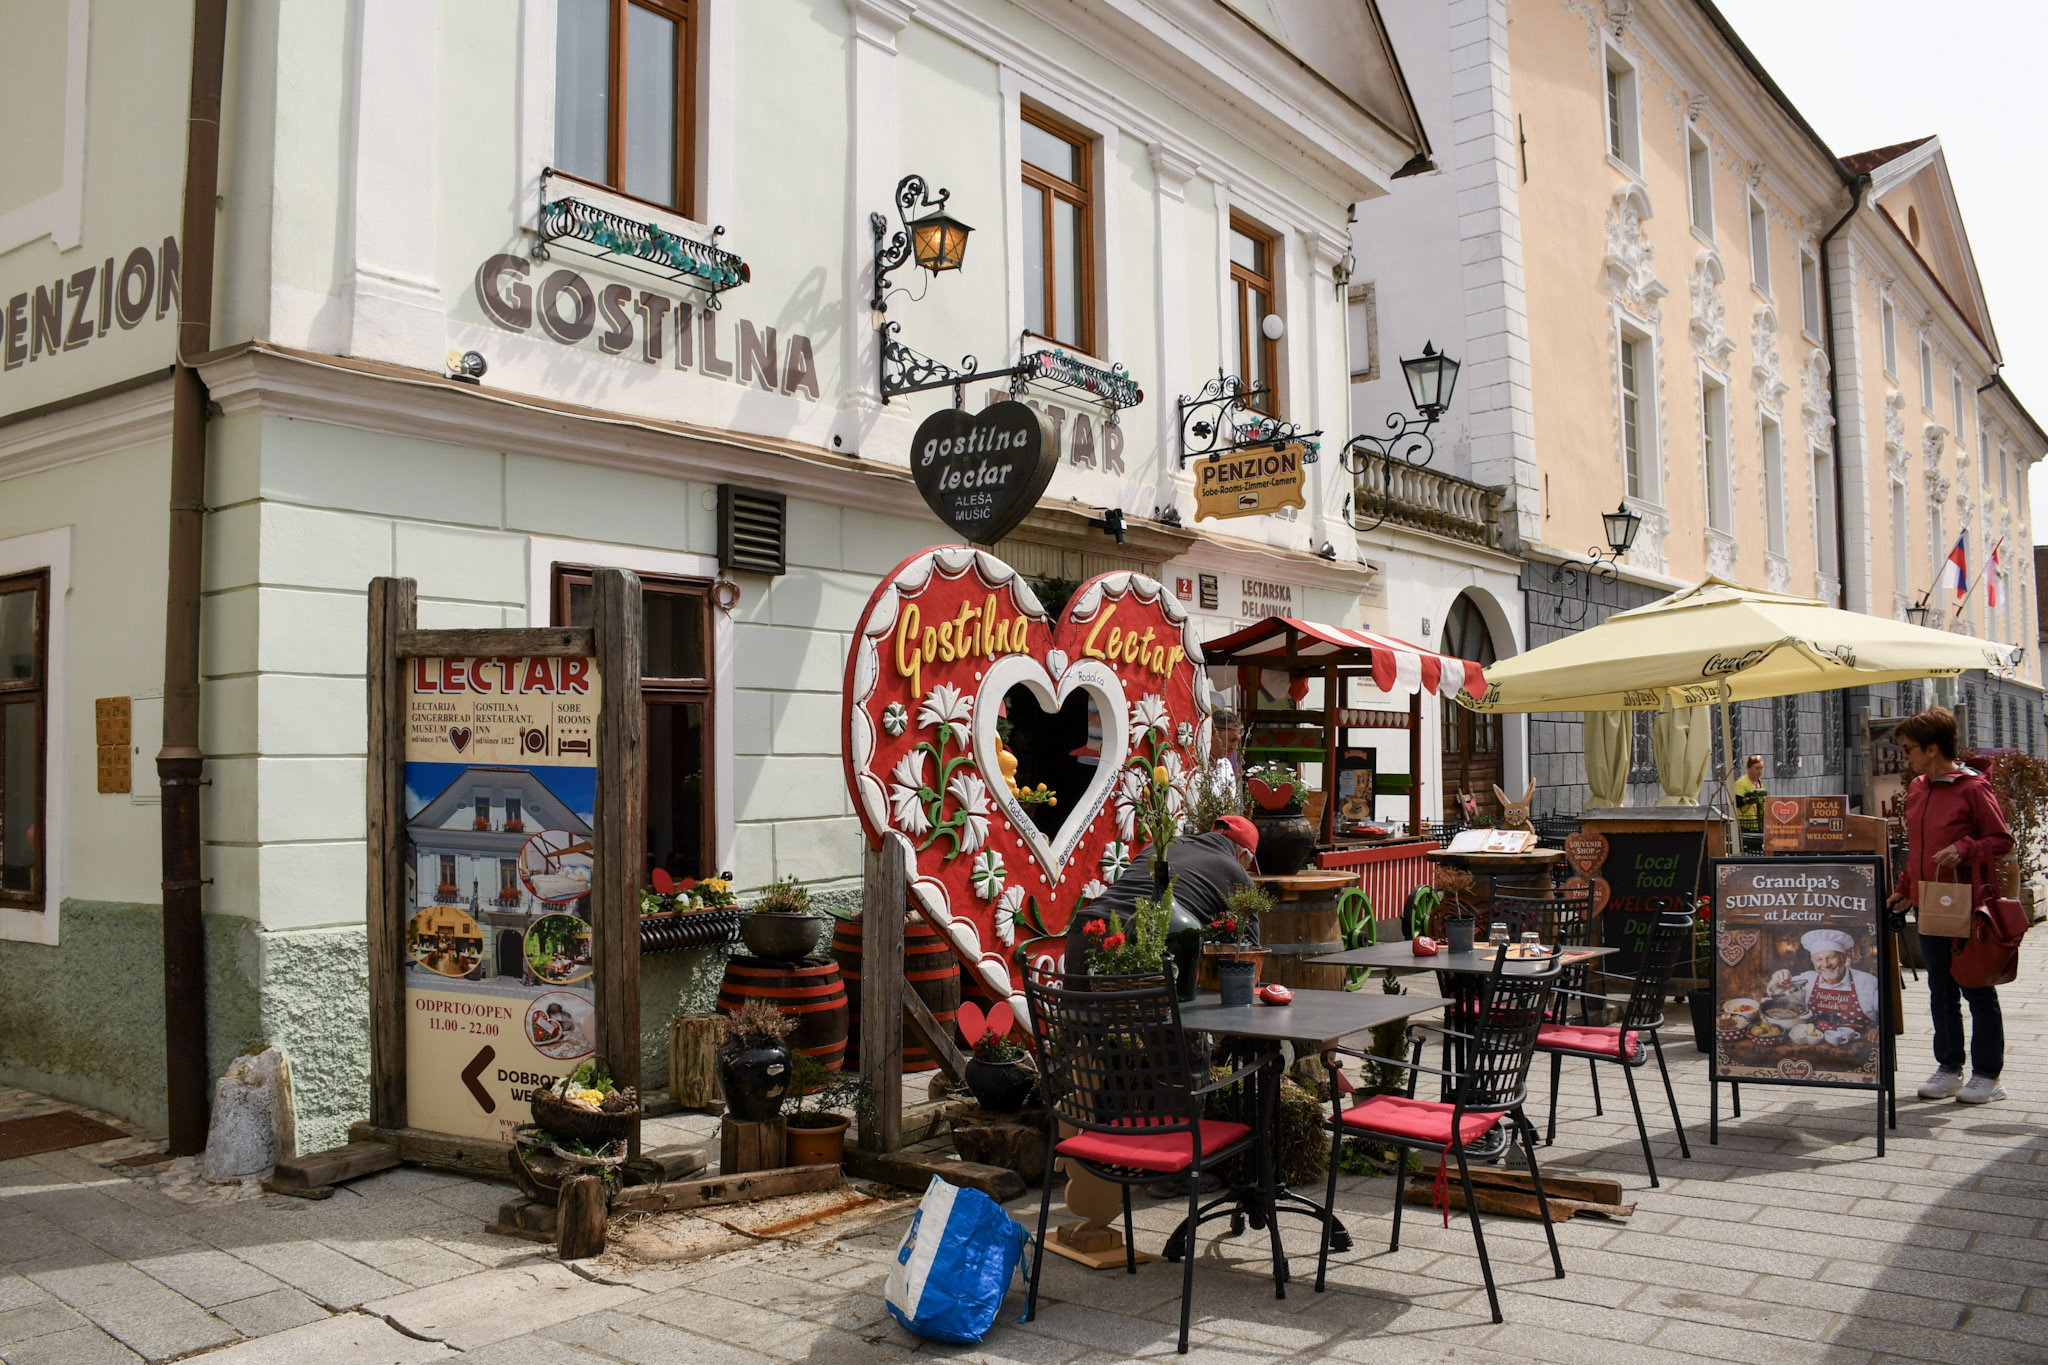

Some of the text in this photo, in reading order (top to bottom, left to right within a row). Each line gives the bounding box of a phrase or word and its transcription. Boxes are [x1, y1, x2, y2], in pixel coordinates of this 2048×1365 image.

[0, 236, 180, 372] ENZION
[475, 253, 820, 402] GOSTILNA
[921, 424, 1027, 467] gostilna
[939, 460, 1013, 491] lectar
[1202, 453, 1296, 486] PENZION
[955, 492, 993, 507] ALEŠA
[1182, 580, 1189, 592] 2
[1242, 579, 1292, 602] LECTARSKA
[1242, 600, 1292, 619] DELAVNICA
[896, 594, 1030, 699] Gostilna
[1082, 604, 1185, 680] Lectar
[414, 657, 591, 695] LECTAR
[412, 702, 456, 712] LECTARIJA
[475, 702, 519, 712] GOSTILNA
[557, 703, 581, 713] SOBE
[411, 713, 471, 723] GINGERBREAD
[475, 714, 534, 725] RESTAURANT,
[557, 715, 591, 725] ROOMS
[411, 725, 447, 734] MUSEUM
[475, 725, 491, 735] INN
[434, 736, 449, 744] 1766
[500, 737, 515, 745] 1822
[1811, 801, 1840, 809] LOCAL
[1813, 808, 1839, 817] FOOD
[1569, 840, 1602, 849] SOUVENIR
[1576, 847, 1595, 855] SHOP
[1635, 854, 1680, 870] Local
[1636, 872, 1676, 888] food
[1725, 893, 1867, 911] SUNDAY LUNCH
[1764, 909, 1825, 921] at Lectar
[416, 998, 512, 1020] ODPRTO/OPEN
[429, 1017, 458, 1032] 11.00
[469, 1021, 499, 1037] 22.00
